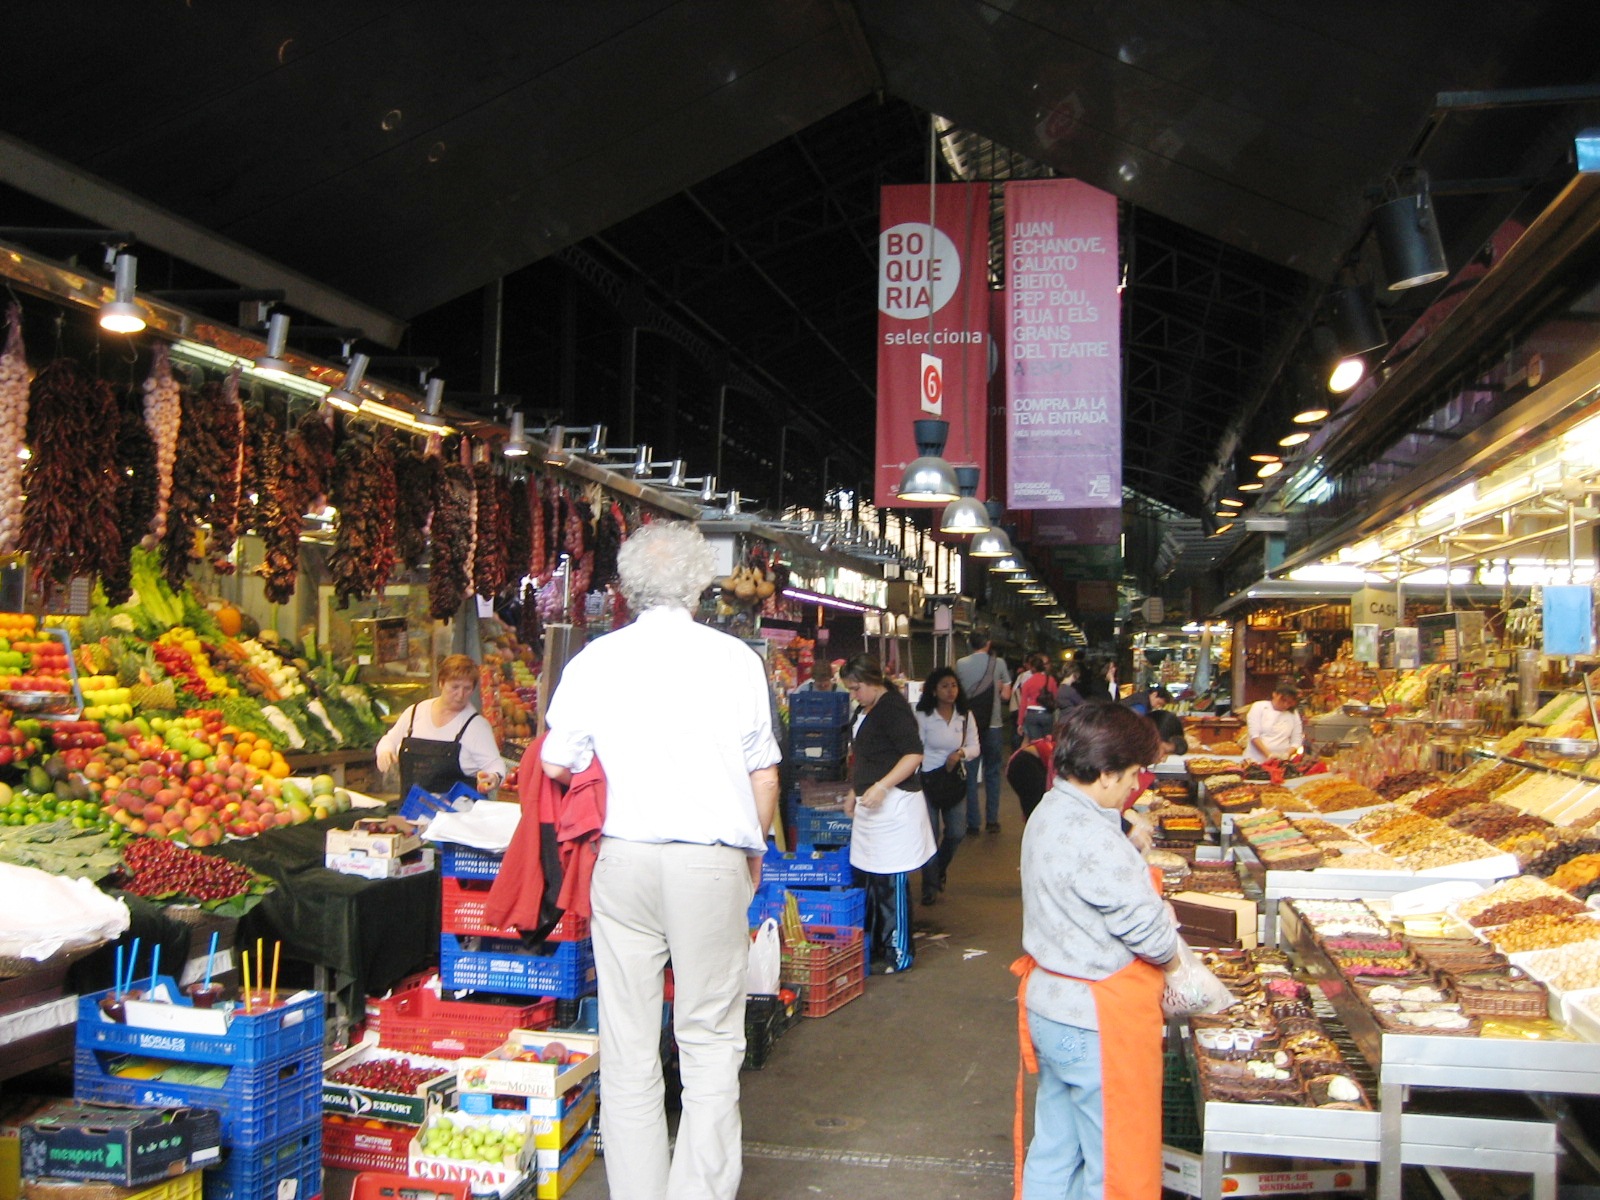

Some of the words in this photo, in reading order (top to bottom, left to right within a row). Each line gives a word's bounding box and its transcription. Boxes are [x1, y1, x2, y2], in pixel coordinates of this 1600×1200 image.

[1012, 221, 1054, 238] JUAN
[887, 233, 924, 256] BO
[1013, 237, 1106, 255] ECHANOVE,
[886, 259, 942, 282] QUE
[1013, 255, 1078, 272] CALIXTO
[1013, 272, 1068, 290] BIEITO,
[886, 286, 932, 309] RIA
[1013, 291, 1045, 307] PEP
[1049, 289, 1090, 307] BOU,
[1013, 308, 1054, 324] PUJA
[1058, 308, 1063, 323] I
[1068, 306, 1099, 323] ELS
[884, 328, 983, 345] selecciona
[1013, 324, 1072, 342] GRANS
[1014, 343, 1046, 359] DEL
[1048, 341, 1109, 359] TEATRE
[928, 371, 937, 398] 6
[1013, 398, 1070, 412] COMPRA
[1072, 397, 1088, 411] JA
[1091, 396, 1107, 410] LA
[1013, 411, 1045, 425] TEVA
[1048, 410, 1109, 424] ENTRADA
[826, 821, 852, 831] Torre
[140, 1033, 186, 1048] MORALES
[372, 1100, 413, 1115] EXPORT
